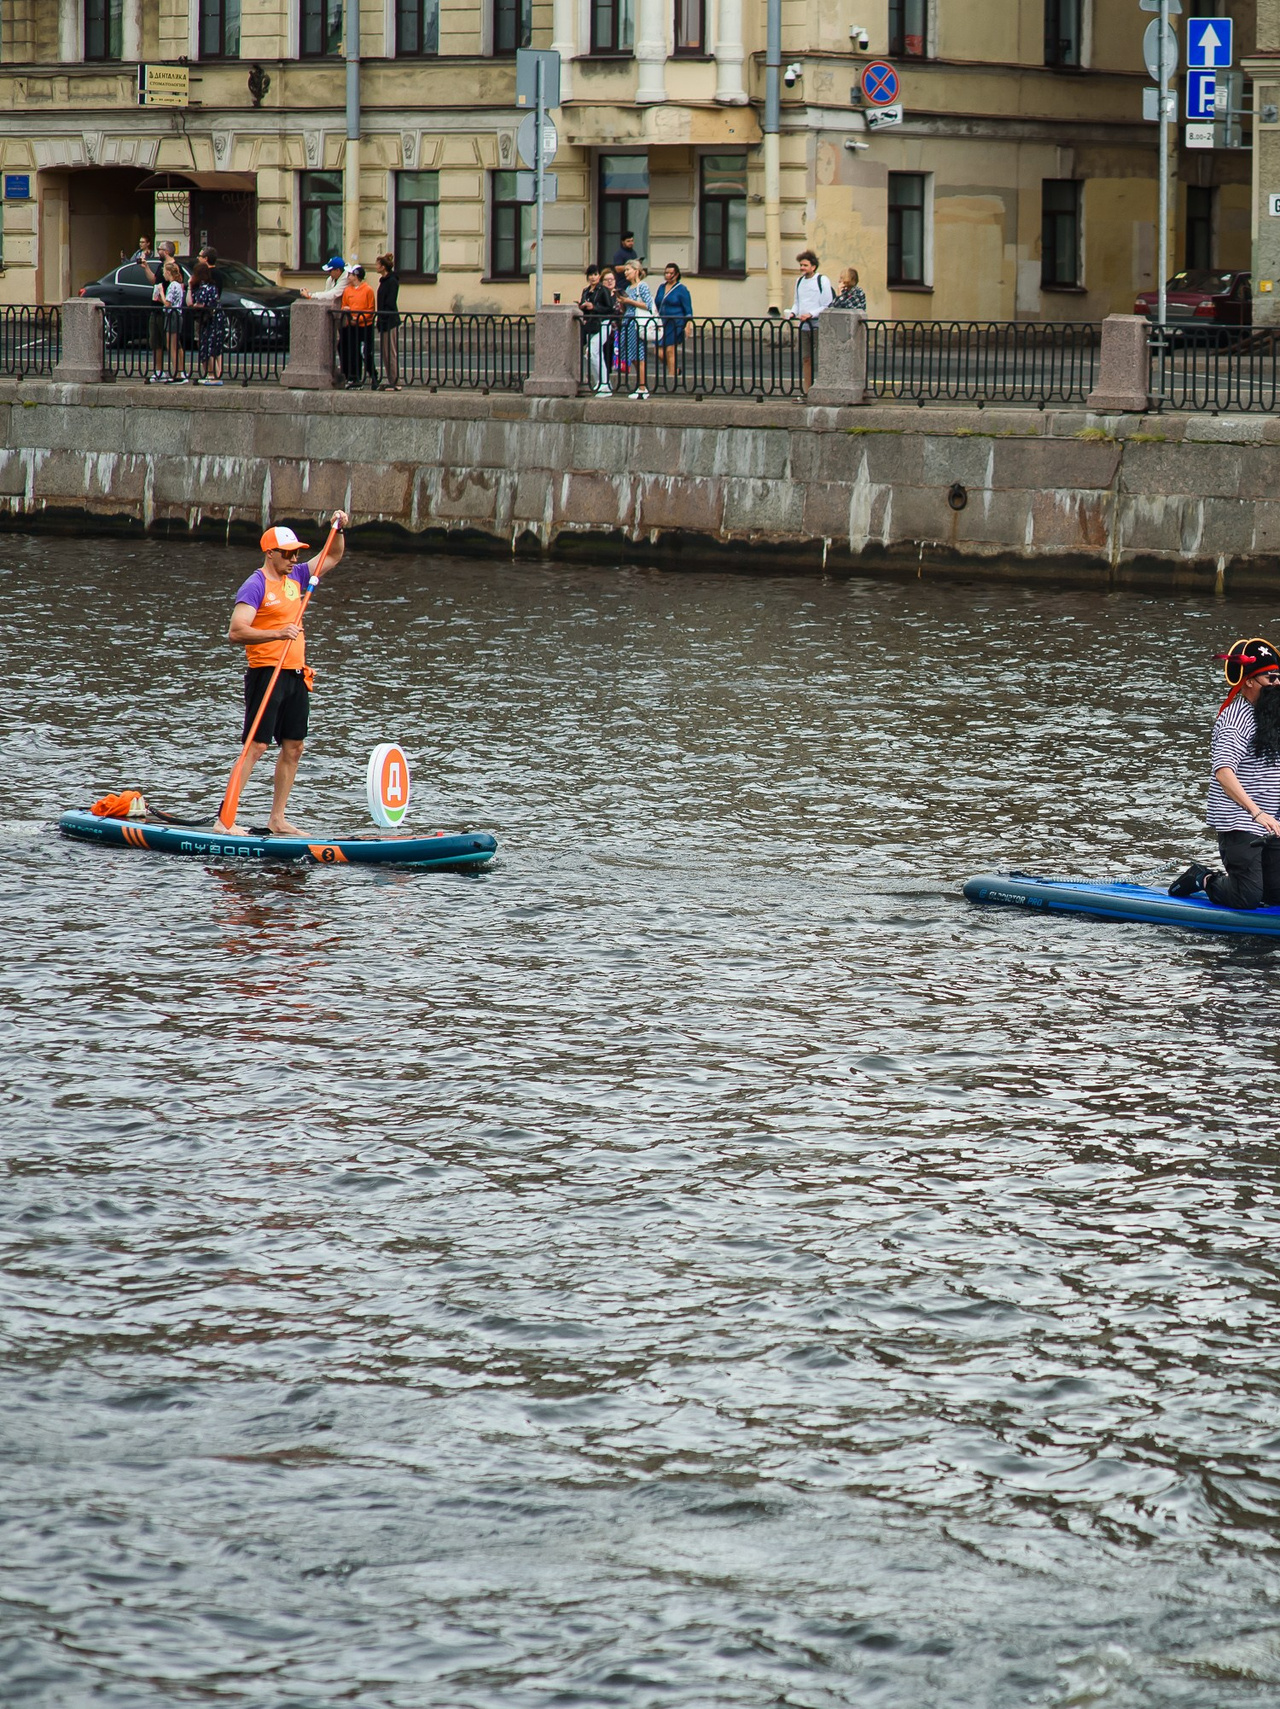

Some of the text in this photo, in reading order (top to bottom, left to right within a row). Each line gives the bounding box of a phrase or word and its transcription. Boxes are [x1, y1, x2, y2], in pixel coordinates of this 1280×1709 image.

[1189, 132, 1214, 141] 8.00-2
[180, 841, 265, 857] MYBOAT
[1028, 897, 1043, 906] PRO
